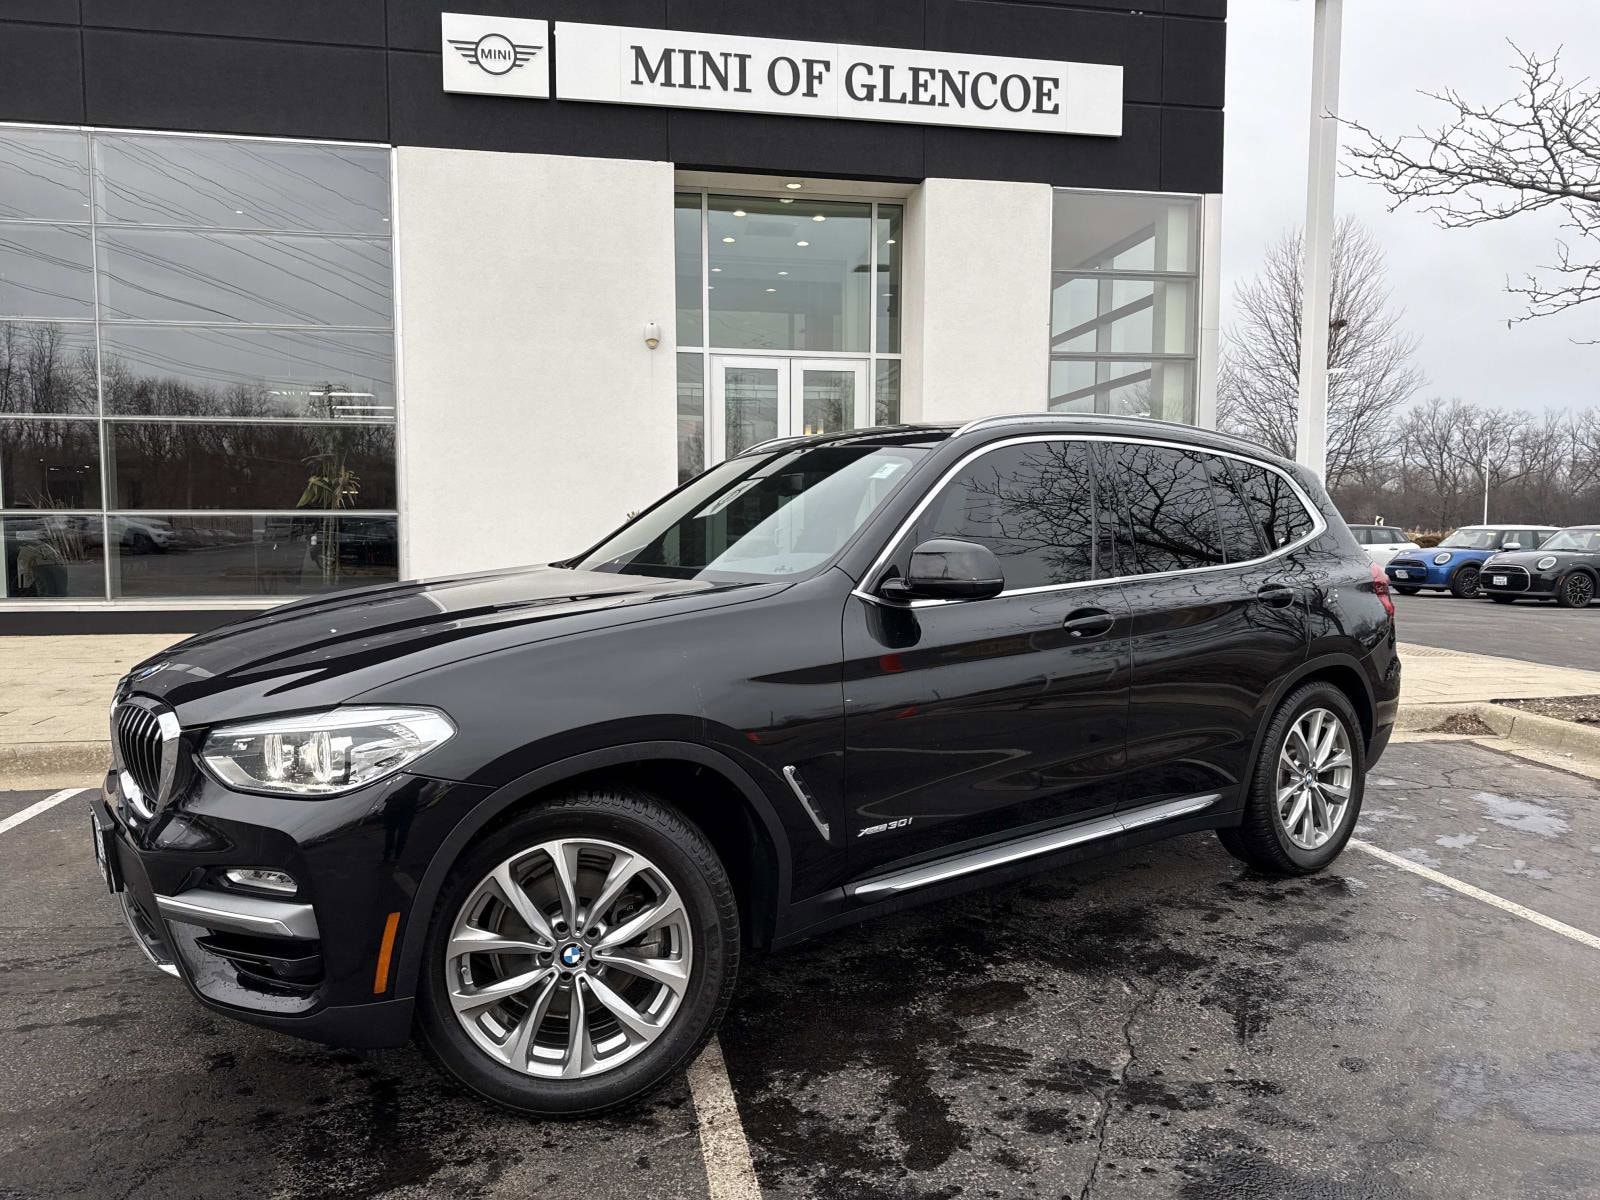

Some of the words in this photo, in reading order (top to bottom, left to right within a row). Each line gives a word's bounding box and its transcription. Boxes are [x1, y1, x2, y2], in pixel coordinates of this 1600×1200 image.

[480, 48, 511, 60] MINI
[630, 45, 752, 93] MINI
[767, 56, 831, 98] OF
[845, 62, 1060, 115] GLENCOE
